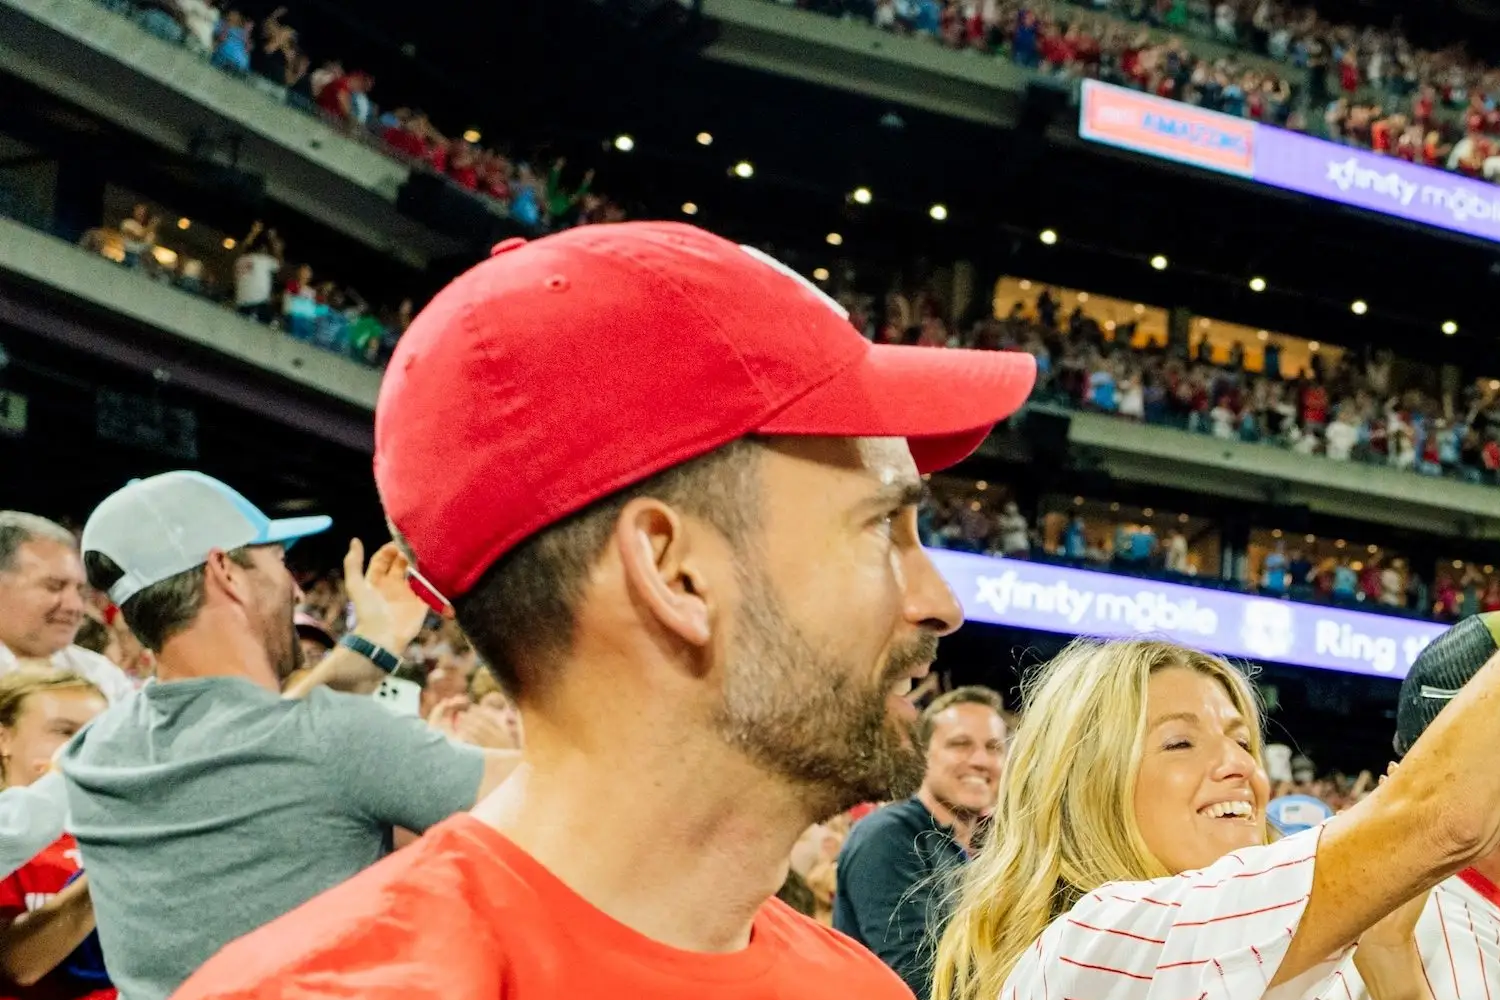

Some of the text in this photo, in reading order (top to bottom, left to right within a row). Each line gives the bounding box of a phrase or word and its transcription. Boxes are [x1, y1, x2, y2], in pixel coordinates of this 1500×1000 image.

[1325, 157, 1418, 206] xfinity
[976, 570, 1218, 635] xfinity mobile
[1316, 619, 1397, 672] Ring
